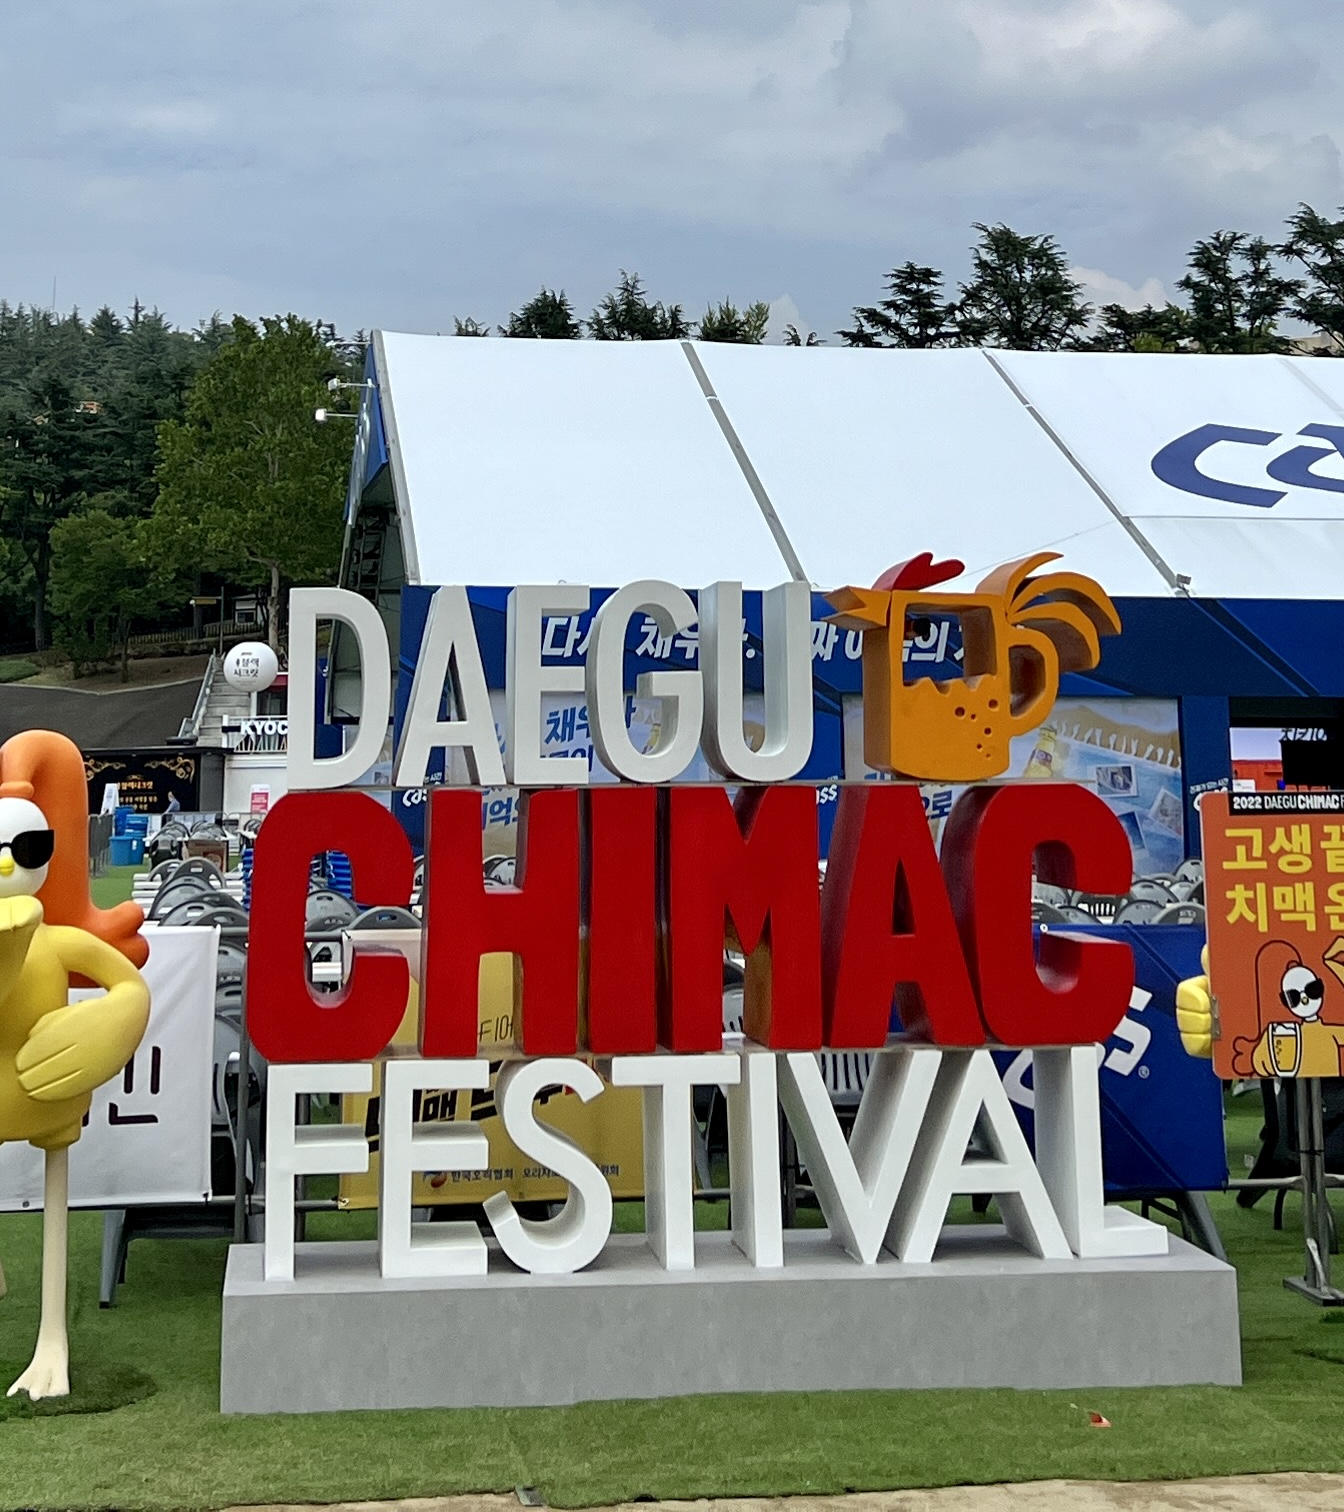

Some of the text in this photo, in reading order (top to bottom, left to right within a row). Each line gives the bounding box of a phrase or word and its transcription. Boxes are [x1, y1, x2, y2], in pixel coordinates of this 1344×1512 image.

[288, 580, 815, 788] DAEGU
[1222, 823, 1313, 874] 고생
[1233, 795, 1262, 809] 2022
[249, 784, 1134, 1062] CHIMAC
[1225, 881, 1316, 933] 치맥
[264, 1044, 1169, 1282] FESTIVAL
